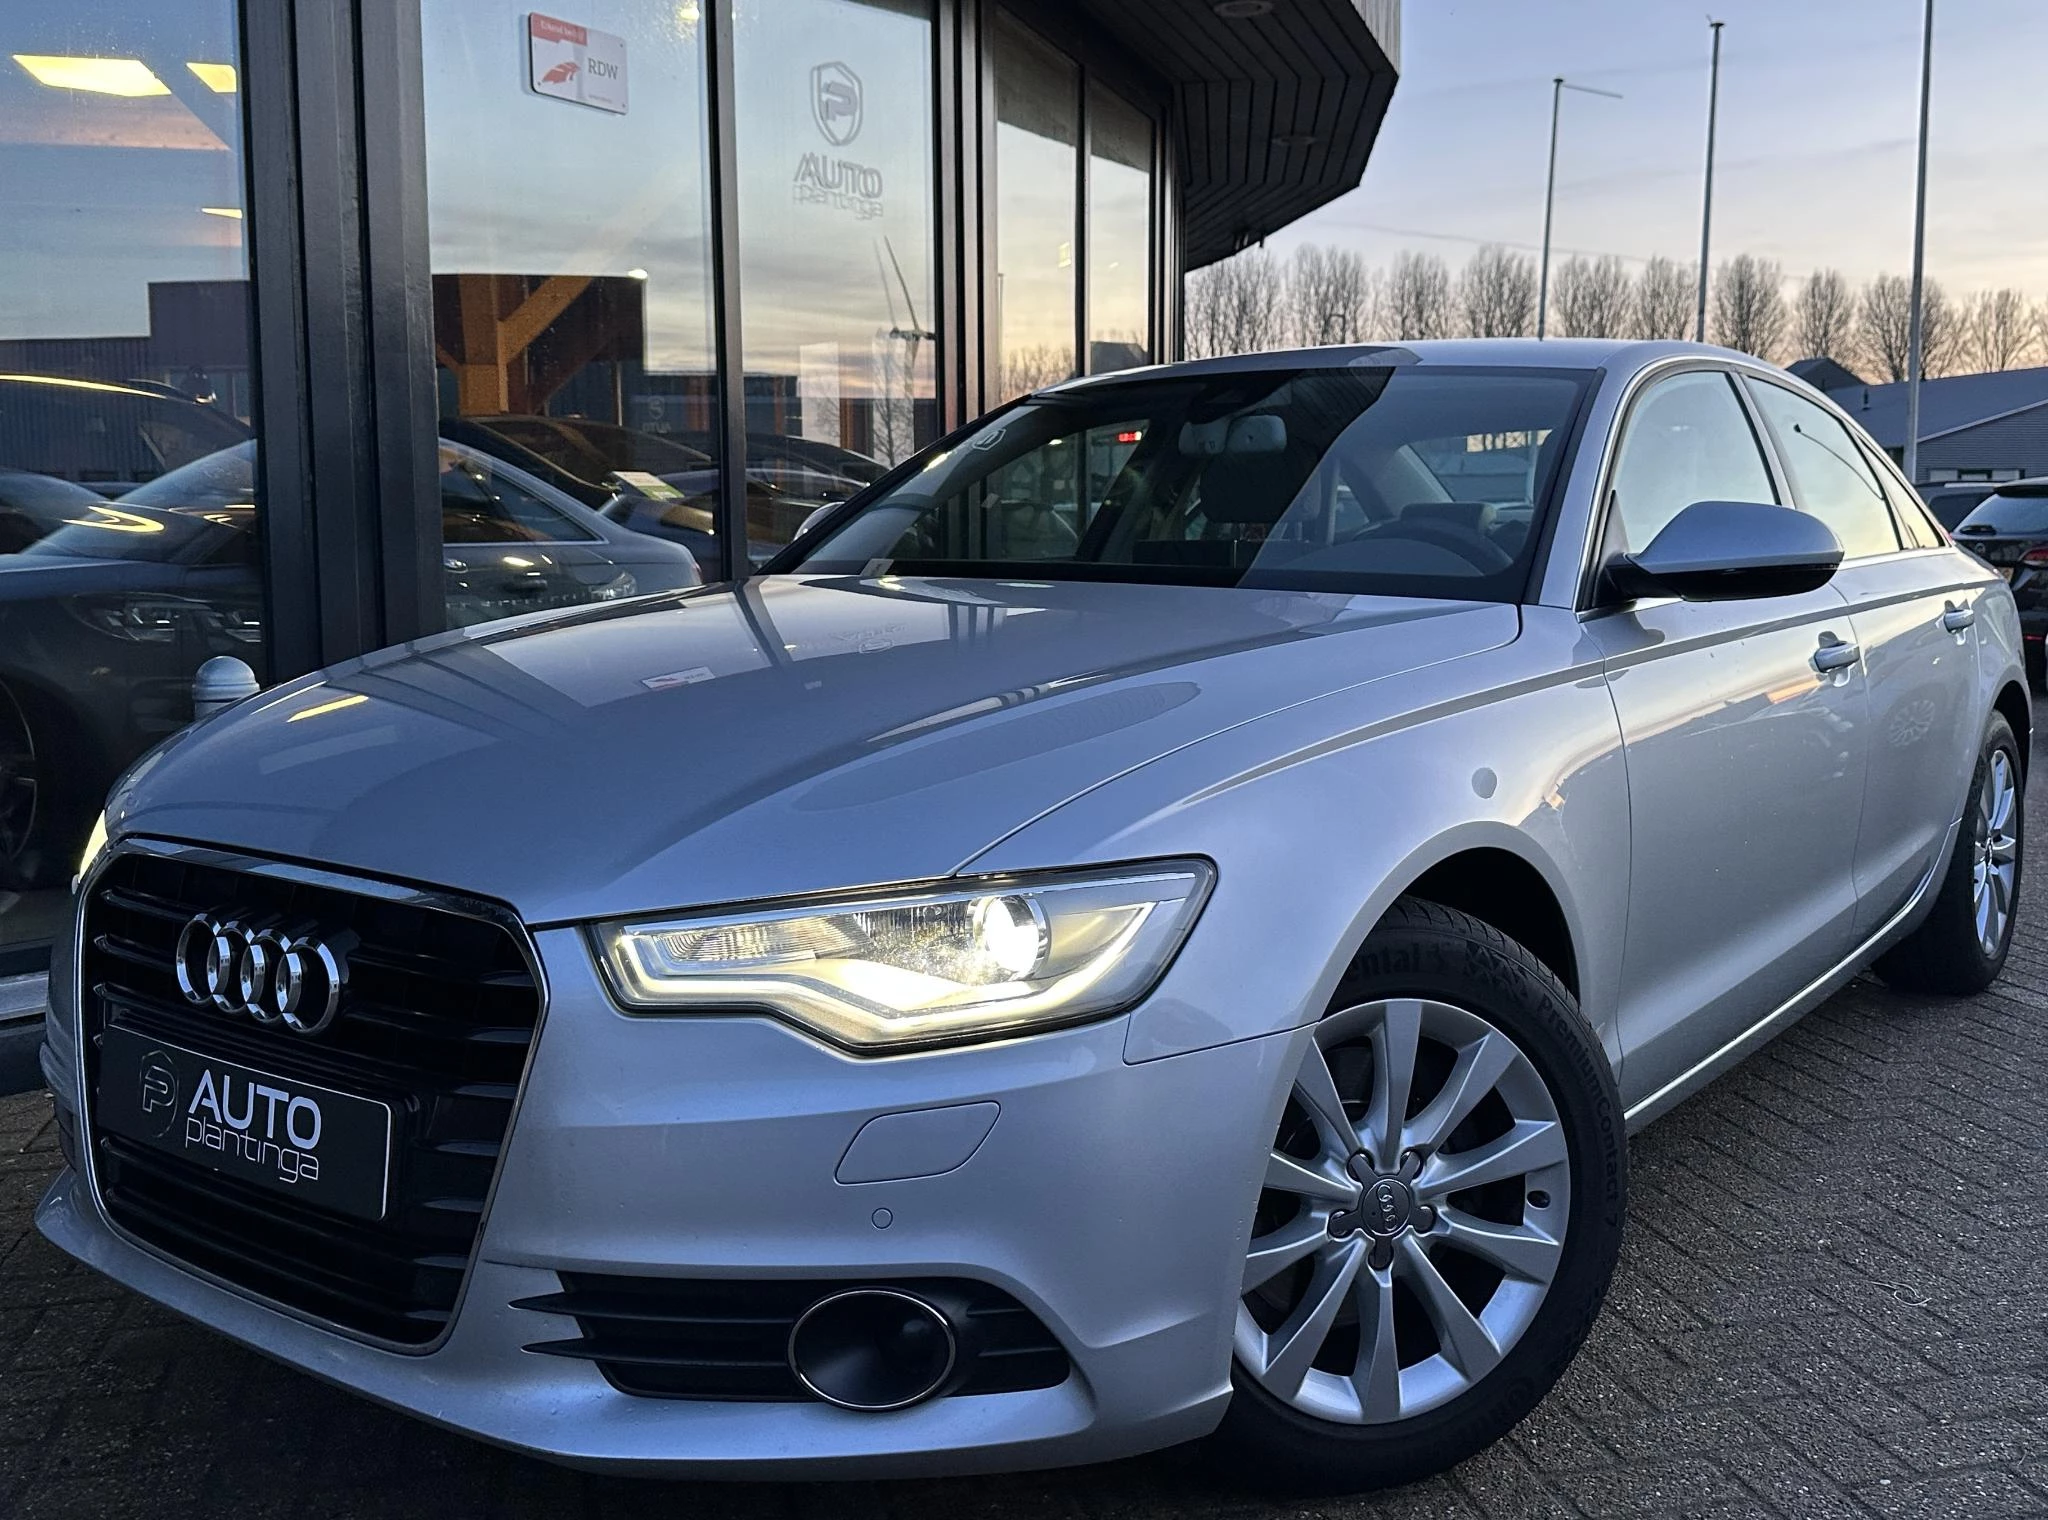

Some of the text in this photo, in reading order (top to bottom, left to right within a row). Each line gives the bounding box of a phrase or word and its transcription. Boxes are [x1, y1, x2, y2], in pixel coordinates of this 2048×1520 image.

[588, 58, 619, 80] RDW
[793, 152, 883, 199] AUTO
[188, 1069, 322, 1150] AUTO
[185, 1116, 320, 1184] plantinga
